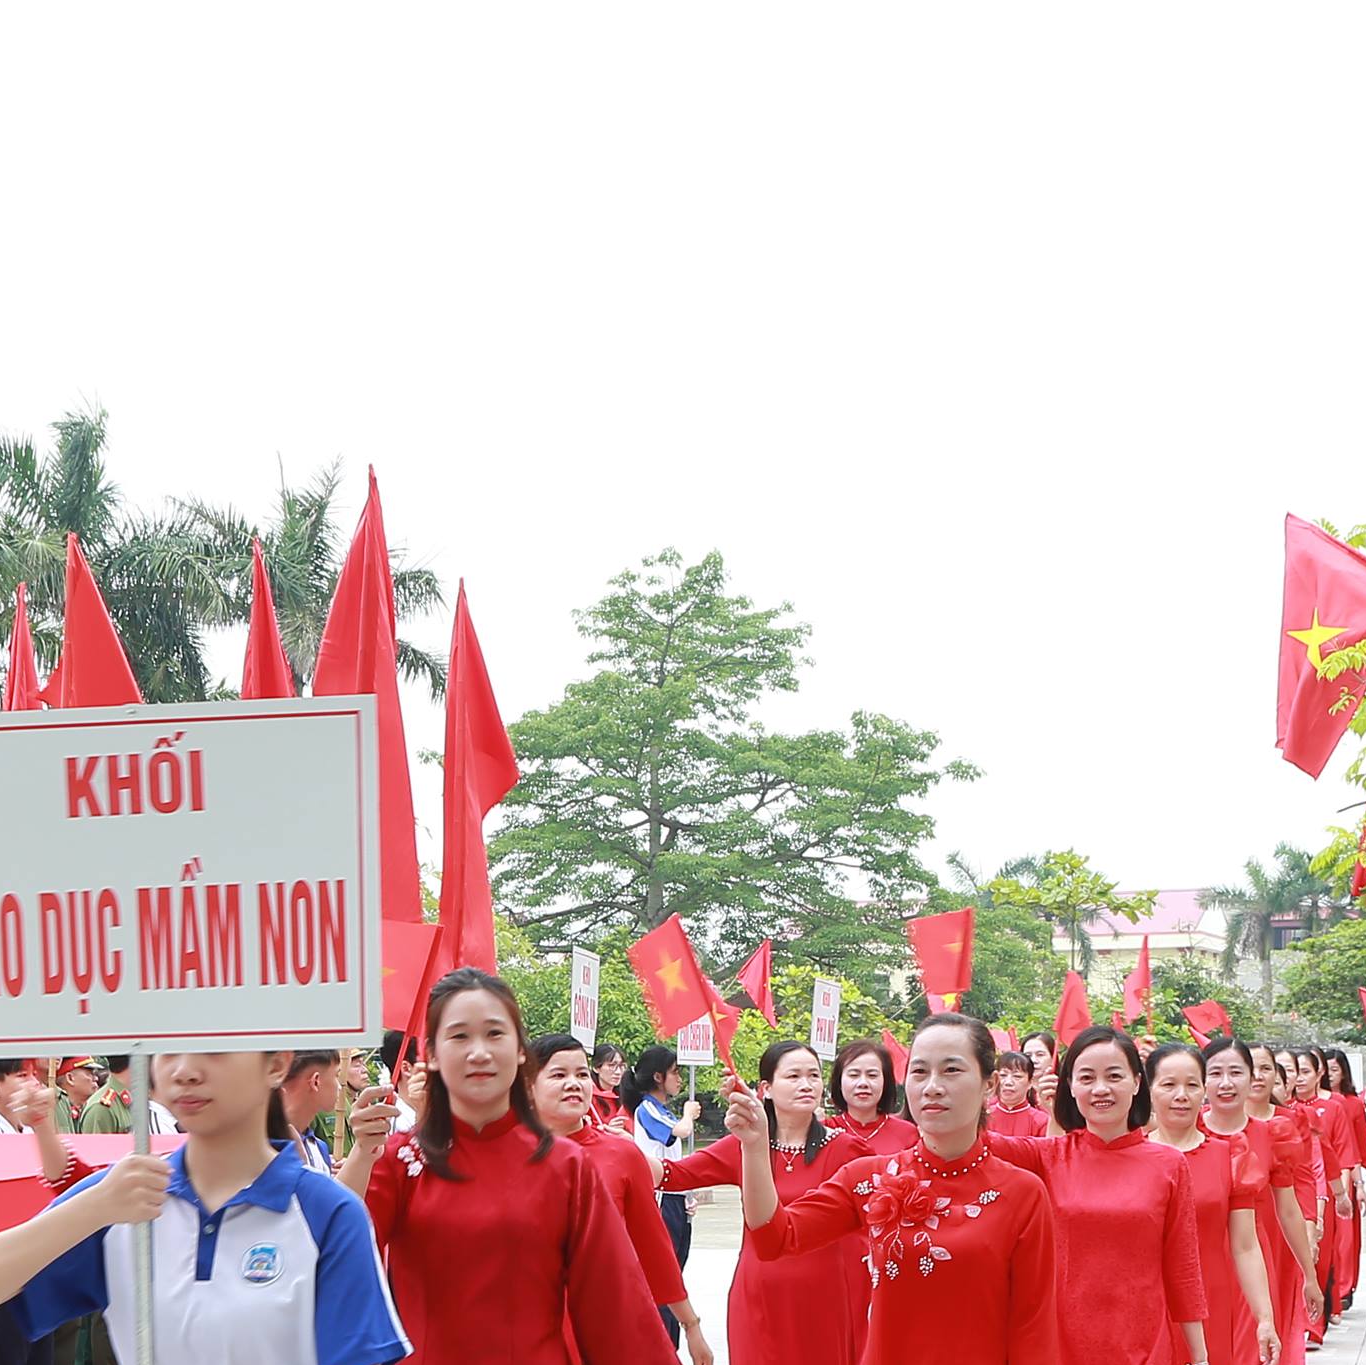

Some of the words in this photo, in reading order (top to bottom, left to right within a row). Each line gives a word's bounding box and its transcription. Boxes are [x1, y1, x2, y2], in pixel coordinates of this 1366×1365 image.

[64, 732, 205, 818] KHỐI
[39, 888, 122, 1015] DỤC
[136, 856, 242, 990] MẦM
[258, 879, 347, 986] NON
